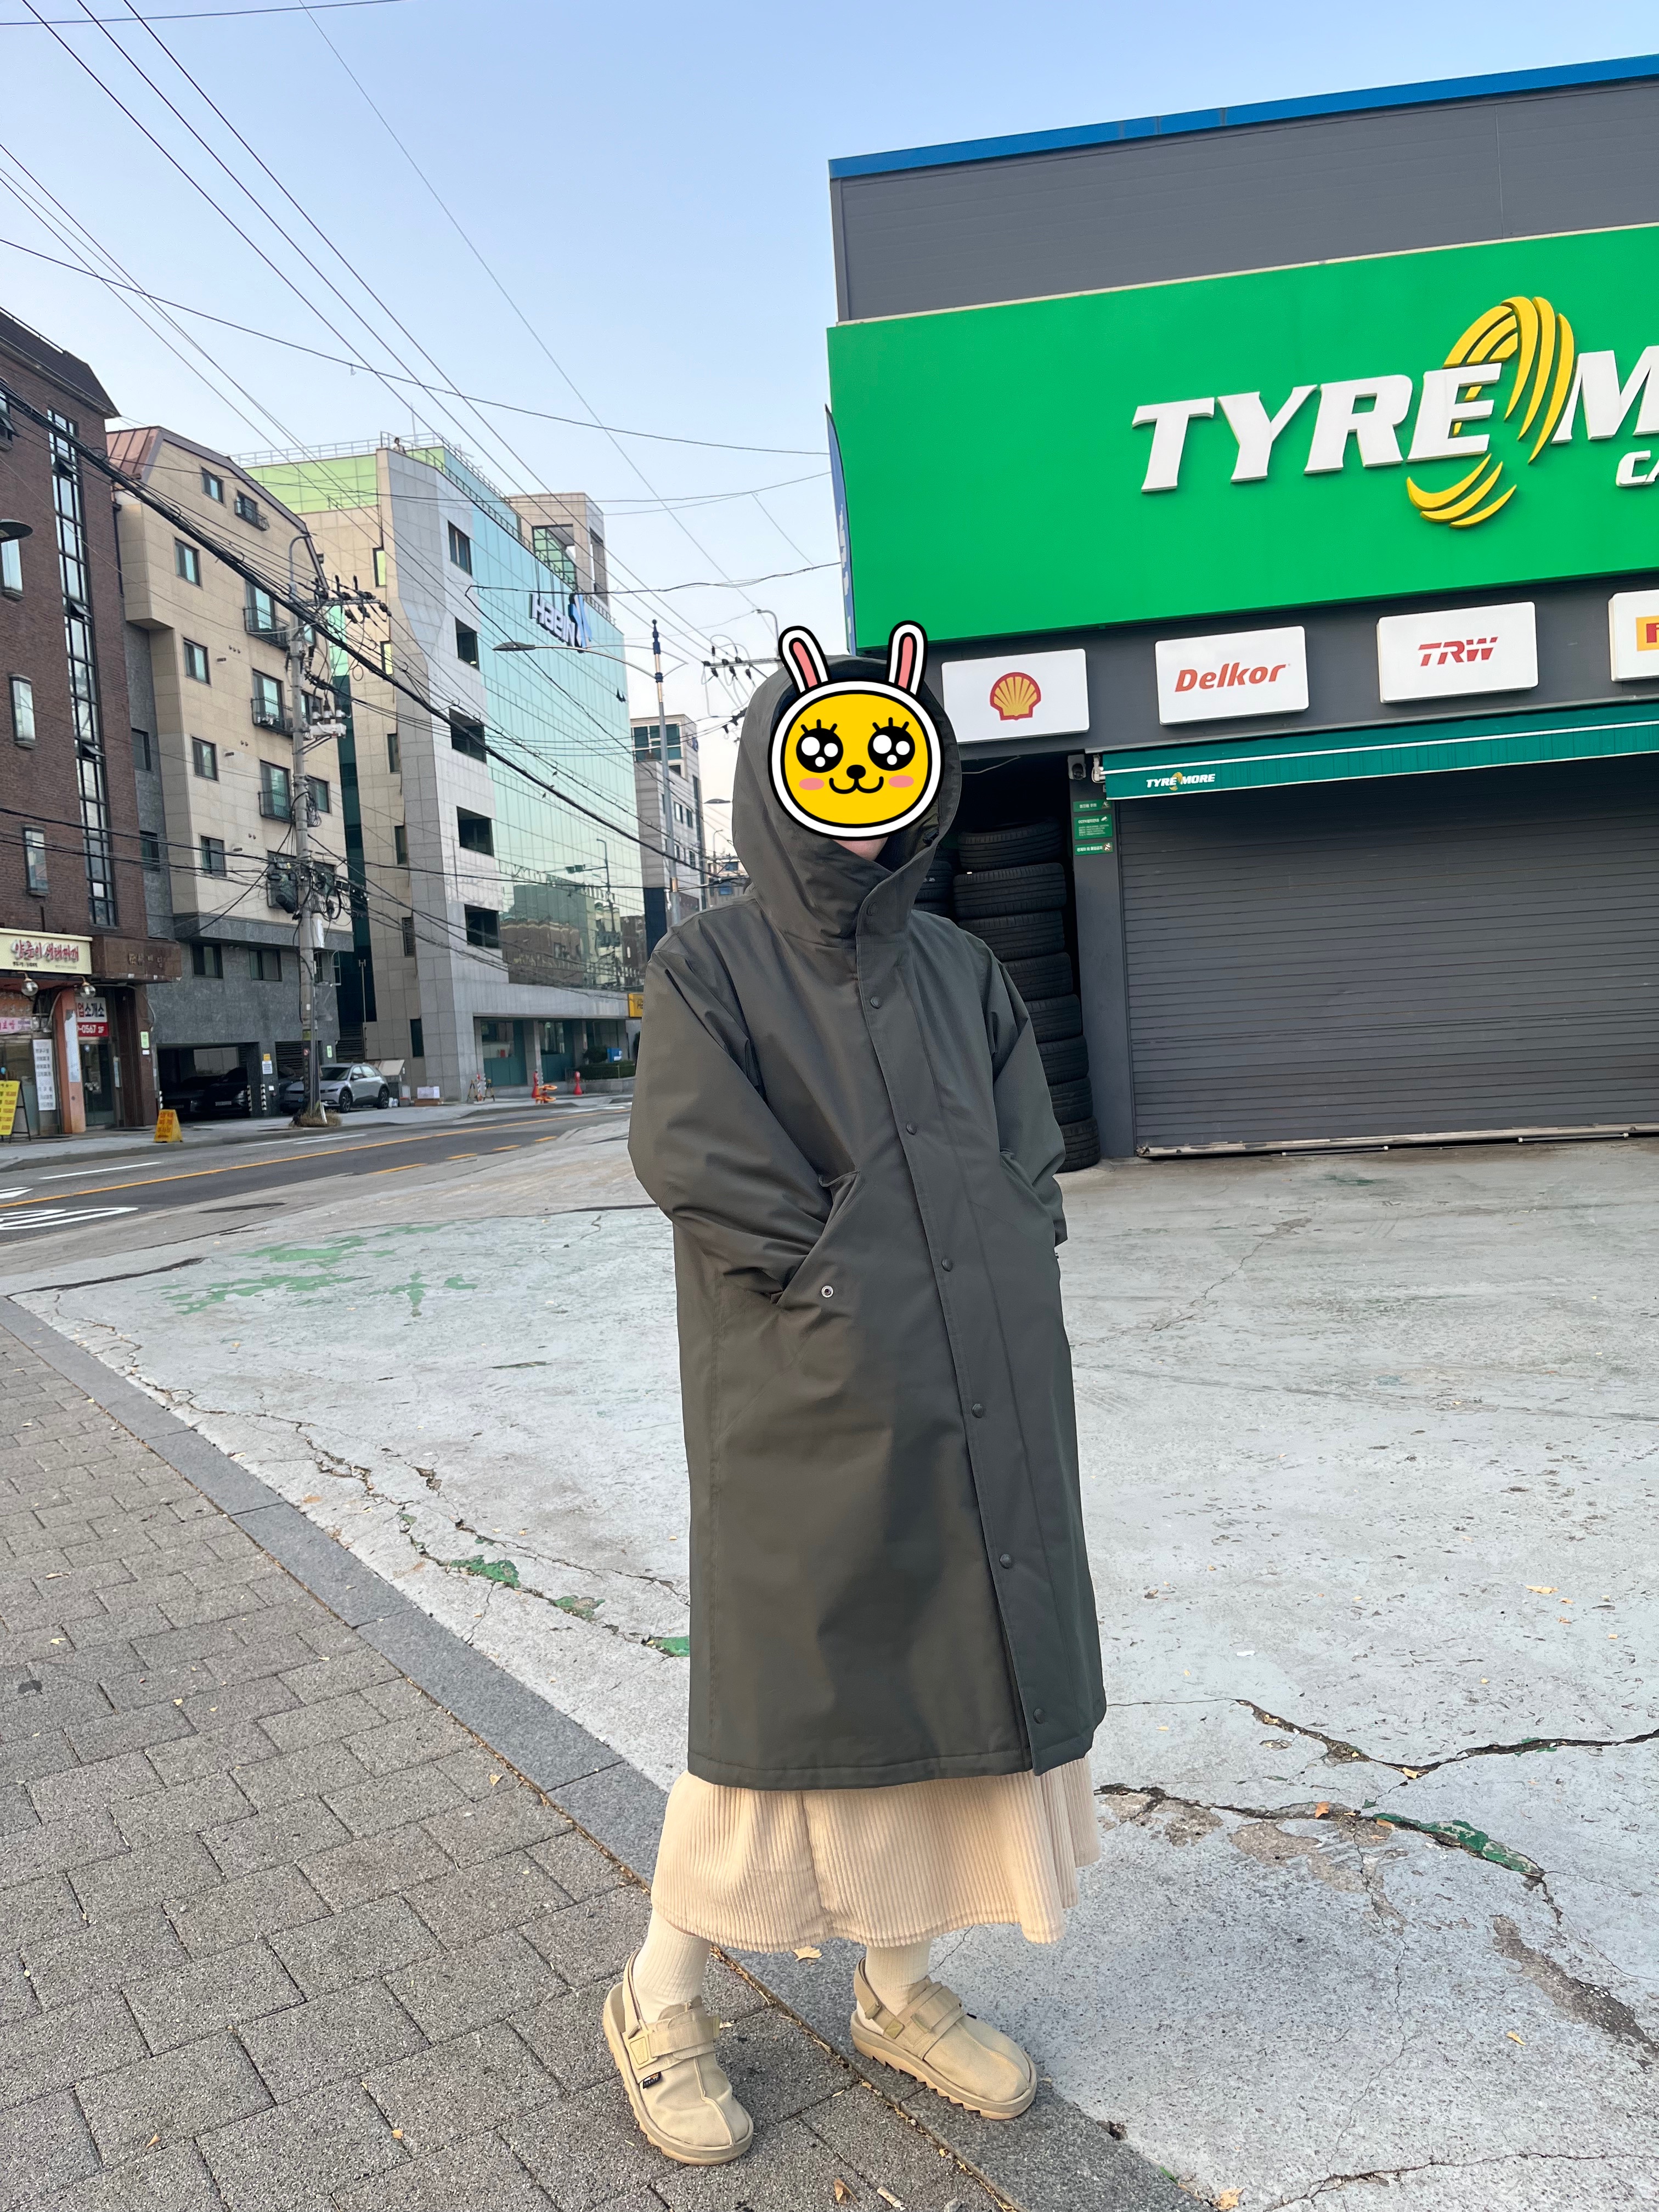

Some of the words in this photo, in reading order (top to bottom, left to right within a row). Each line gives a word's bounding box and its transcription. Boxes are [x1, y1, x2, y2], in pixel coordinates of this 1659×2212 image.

[1132, 363, 1502, 493] TYRE
[1418, 636, 1498, 667] TRW
[1175, 662, 1286, 692] Delkor
[1146, 777, 1177, 788] TYRE
[1180, 774, 1216, 785] MORE
